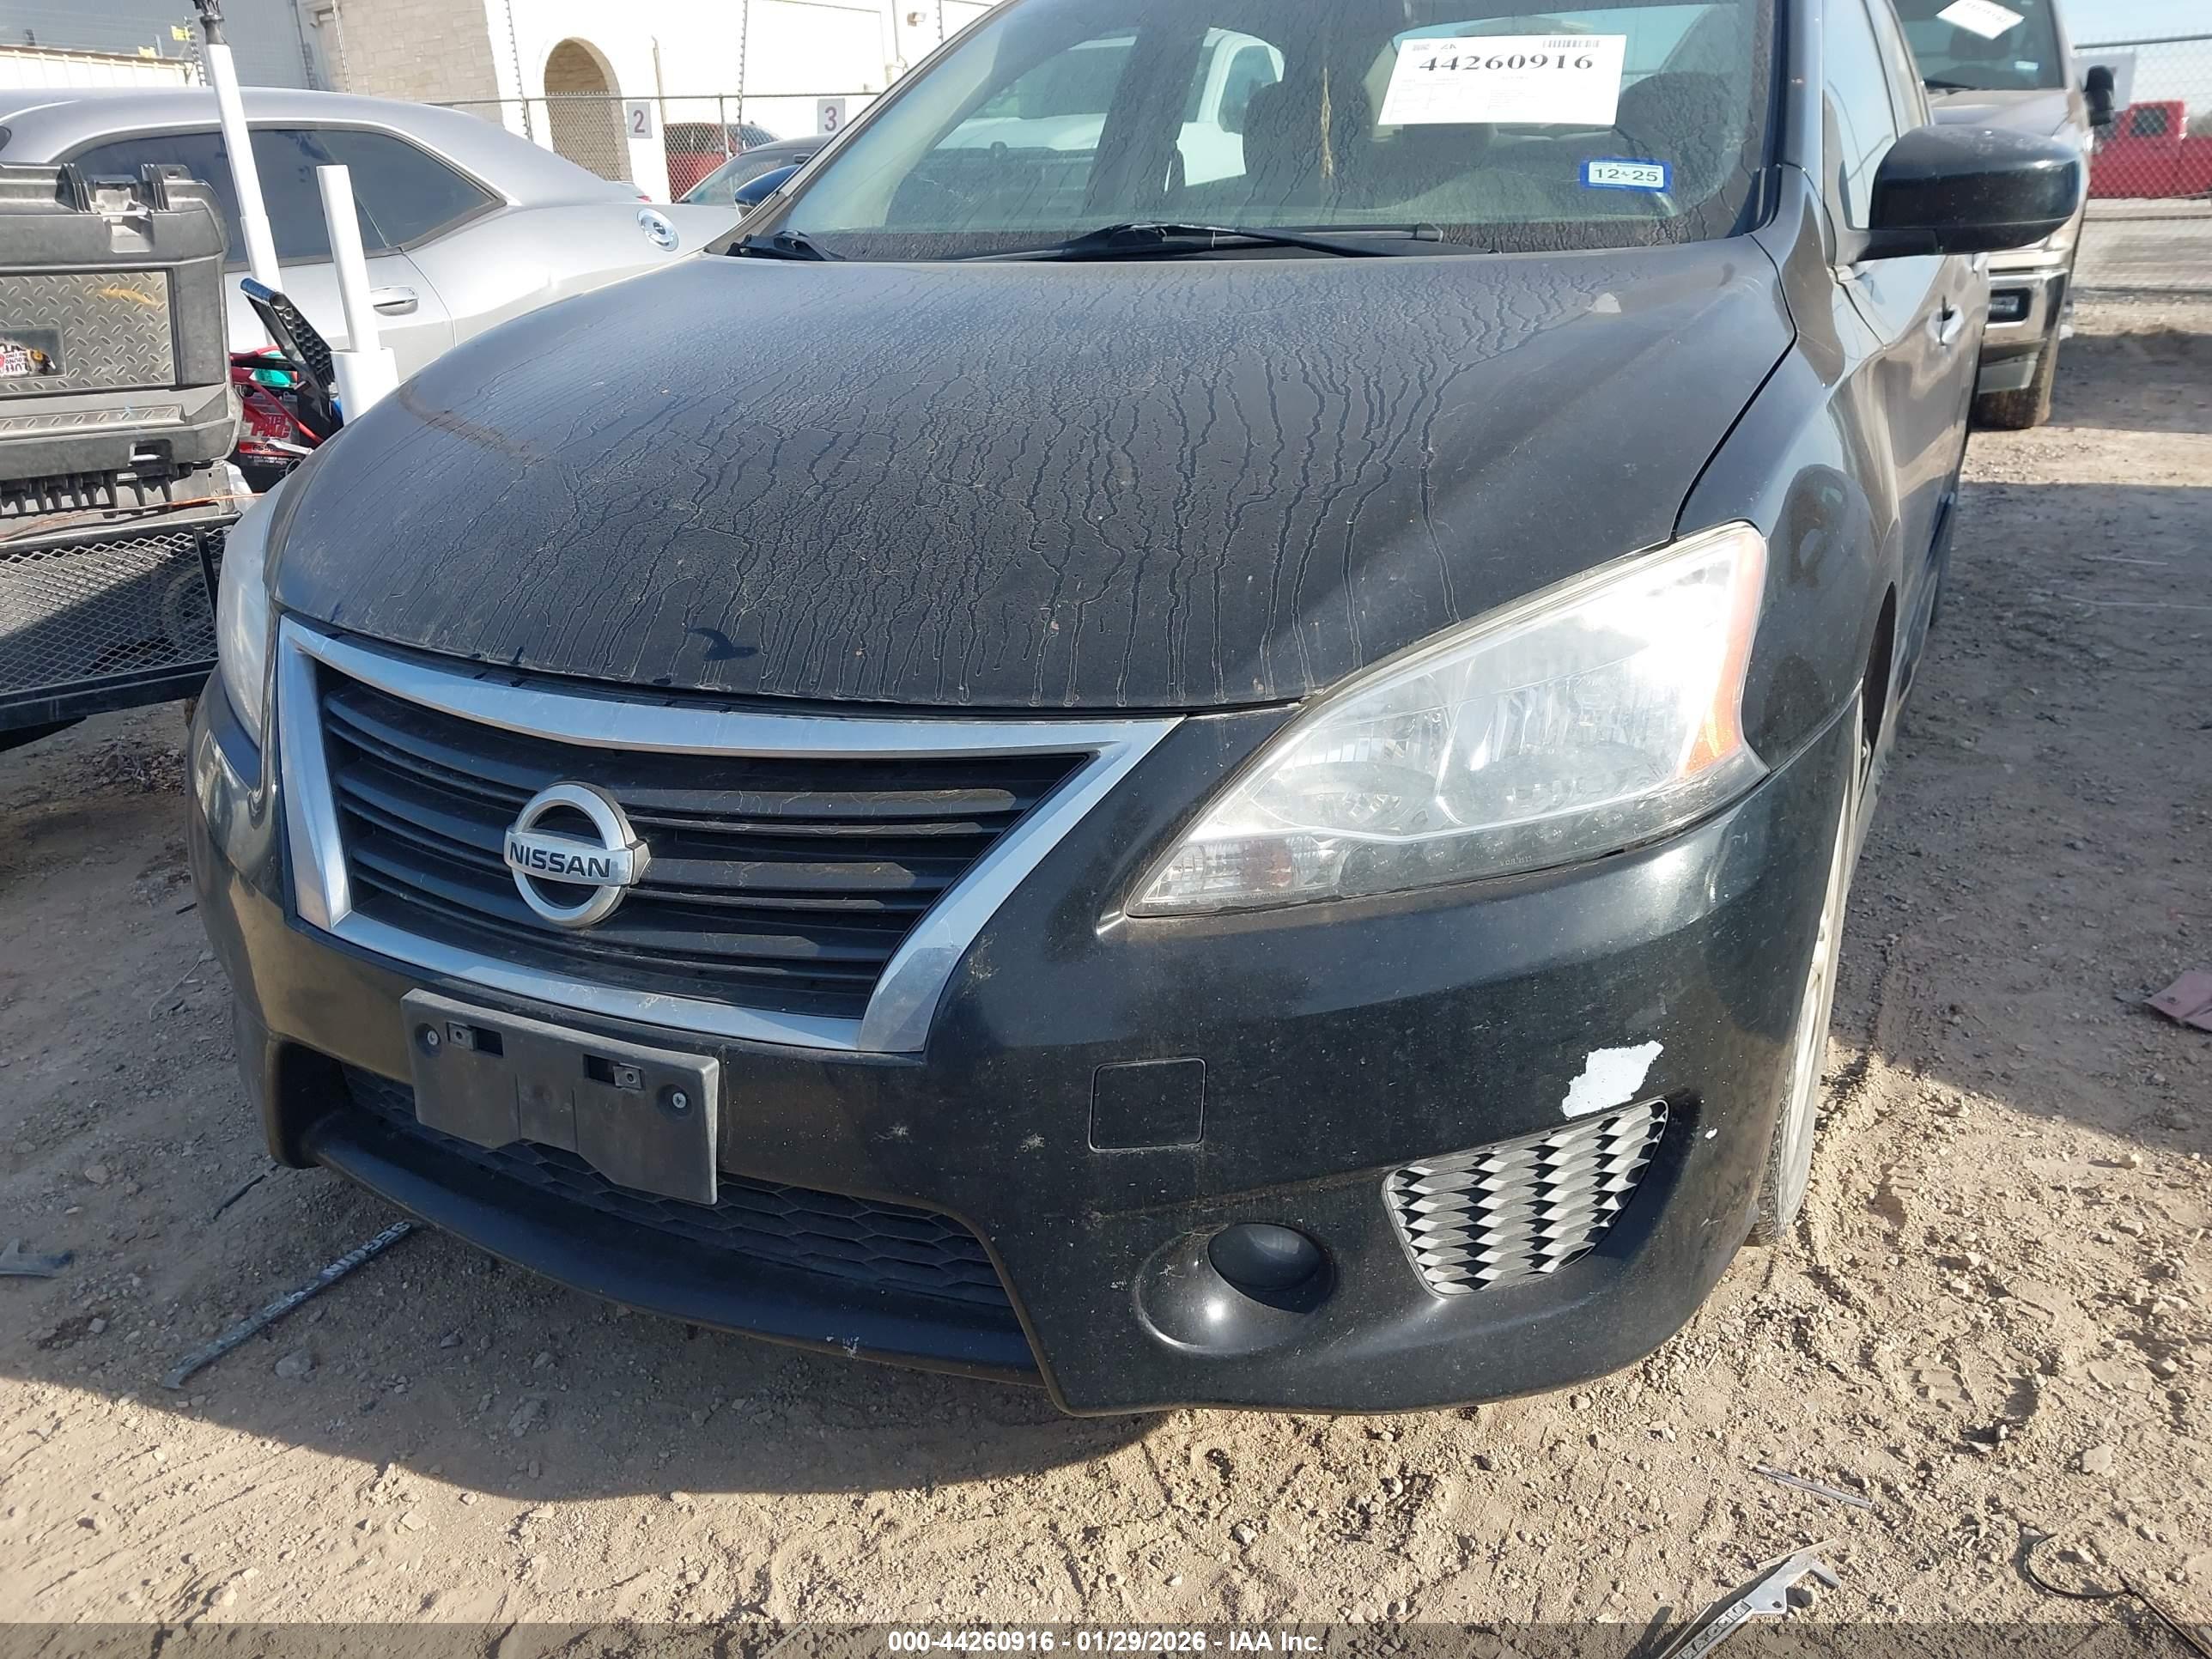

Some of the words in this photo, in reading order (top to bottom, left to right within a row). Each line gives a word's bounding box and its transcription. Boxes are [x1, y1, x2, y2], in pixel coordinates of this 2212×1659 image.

[1419, 54, 1594, 71] 44260916
[633, 109, 647, 134] 2
[823, 106, 838, 131] 3
[509, 842, 612, 878] NISSAN
[1673, 1599, 1753, 1659] RA.COM
